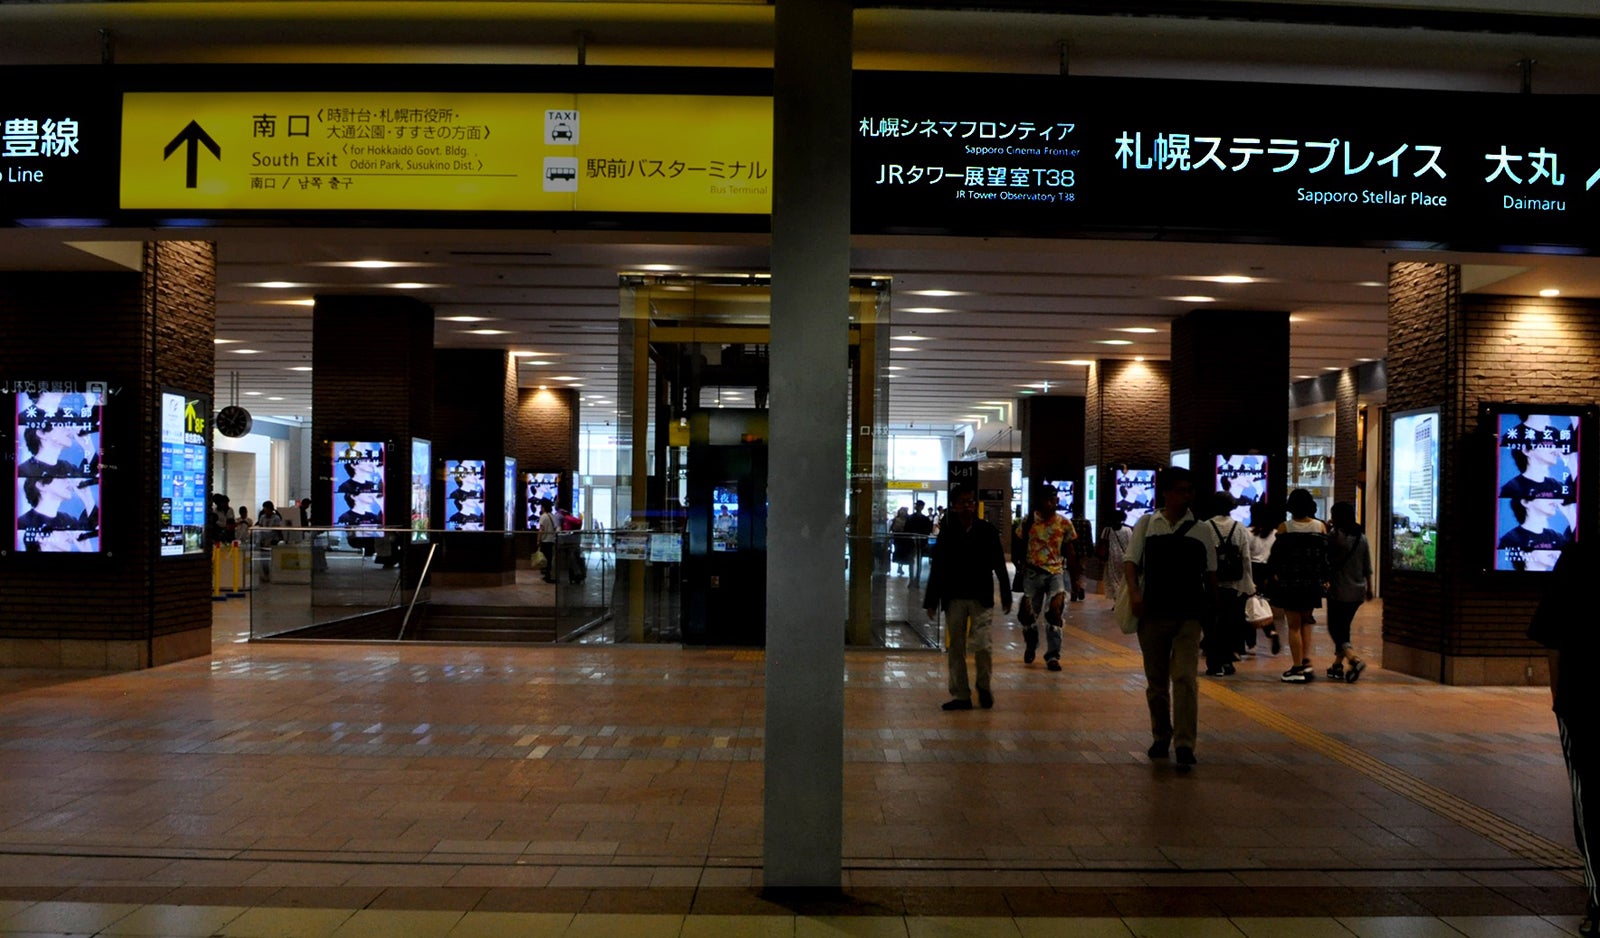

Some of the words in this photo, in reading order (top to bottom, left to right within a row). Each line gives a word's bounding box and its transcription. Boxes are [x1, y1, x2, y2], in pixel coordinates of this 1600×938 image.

[548, 111, 577, 121] TAXI
[252, 113, 310, 138] 南口
[859, 116, 1076, 141] 札幌シネマフロンティア
[0, 118, 79, 157] 豊線
[416, 145, 442, 157] Govt.
[445, 145, 469, 159] Bldg.
[965, 145, 1004, 156] Sapporo
[1006, 145, 1041, 156] Cinema
[1043, 146, 1081, 157] Frontier
[1115, 130, 1448, 179] 札幌ステラプレイス
[252, 152, 298, 168] South
[306, 152, 337, 168] Exit
[380, 160, 403, 172] Park,
[406, 160, 450, 171] Susukino
[1485, 145, 1566, 186] 大丸
[8, 166, 44, 182] Line
[586, 158, 768, 180] 駅前バスターミナル
[876, 163, 1076, 188] JRタワー展望室T38
[251, 177, 276, 190] 南口
[710, 186, 727, 195] Bus
[729, 186, 768, 195] Terminal
[955, 190, 966, 199] JR
[968, 191, 997, 200] Tower
[999, 191, 1056, 203] Observatory
[1058, 192, 1076, 202] T38
[1297, 187, 1358, 205] Sapporo
[1362, 189, 1407, 205] Stellar
[1411, 191, 1447, 207] Place
[1503, 194, 1566, 212] Daimaru
[962, 466, 973, 478] B1
